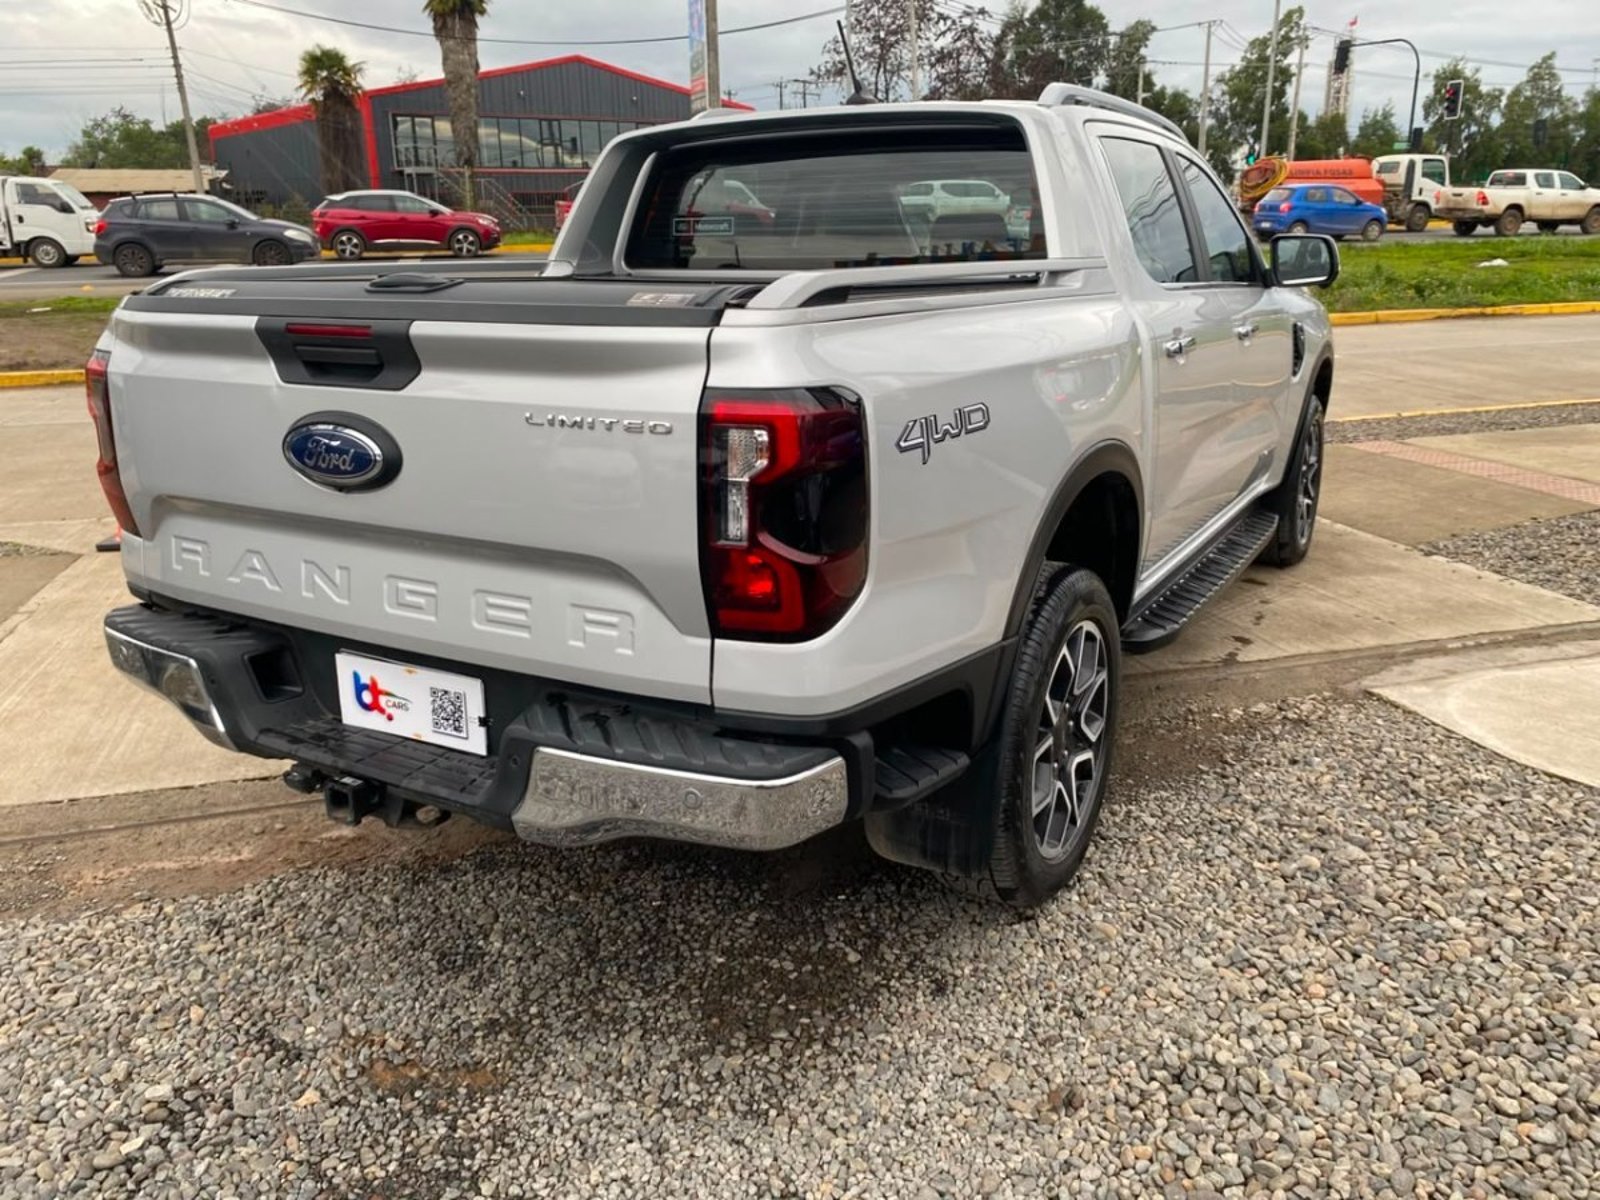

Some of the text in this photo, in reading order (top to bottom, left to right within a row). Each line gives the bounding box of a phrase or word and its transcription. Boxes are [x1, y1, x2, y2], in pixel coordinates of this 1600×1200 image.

[524, 412, 673, 435] LIMITED
[895, 402, 991, 465] 4WD
[303, 436, 356, 471] Ford
[170, 534, 636, 656] RANGER
[385, 699, 410, 712] CARS
